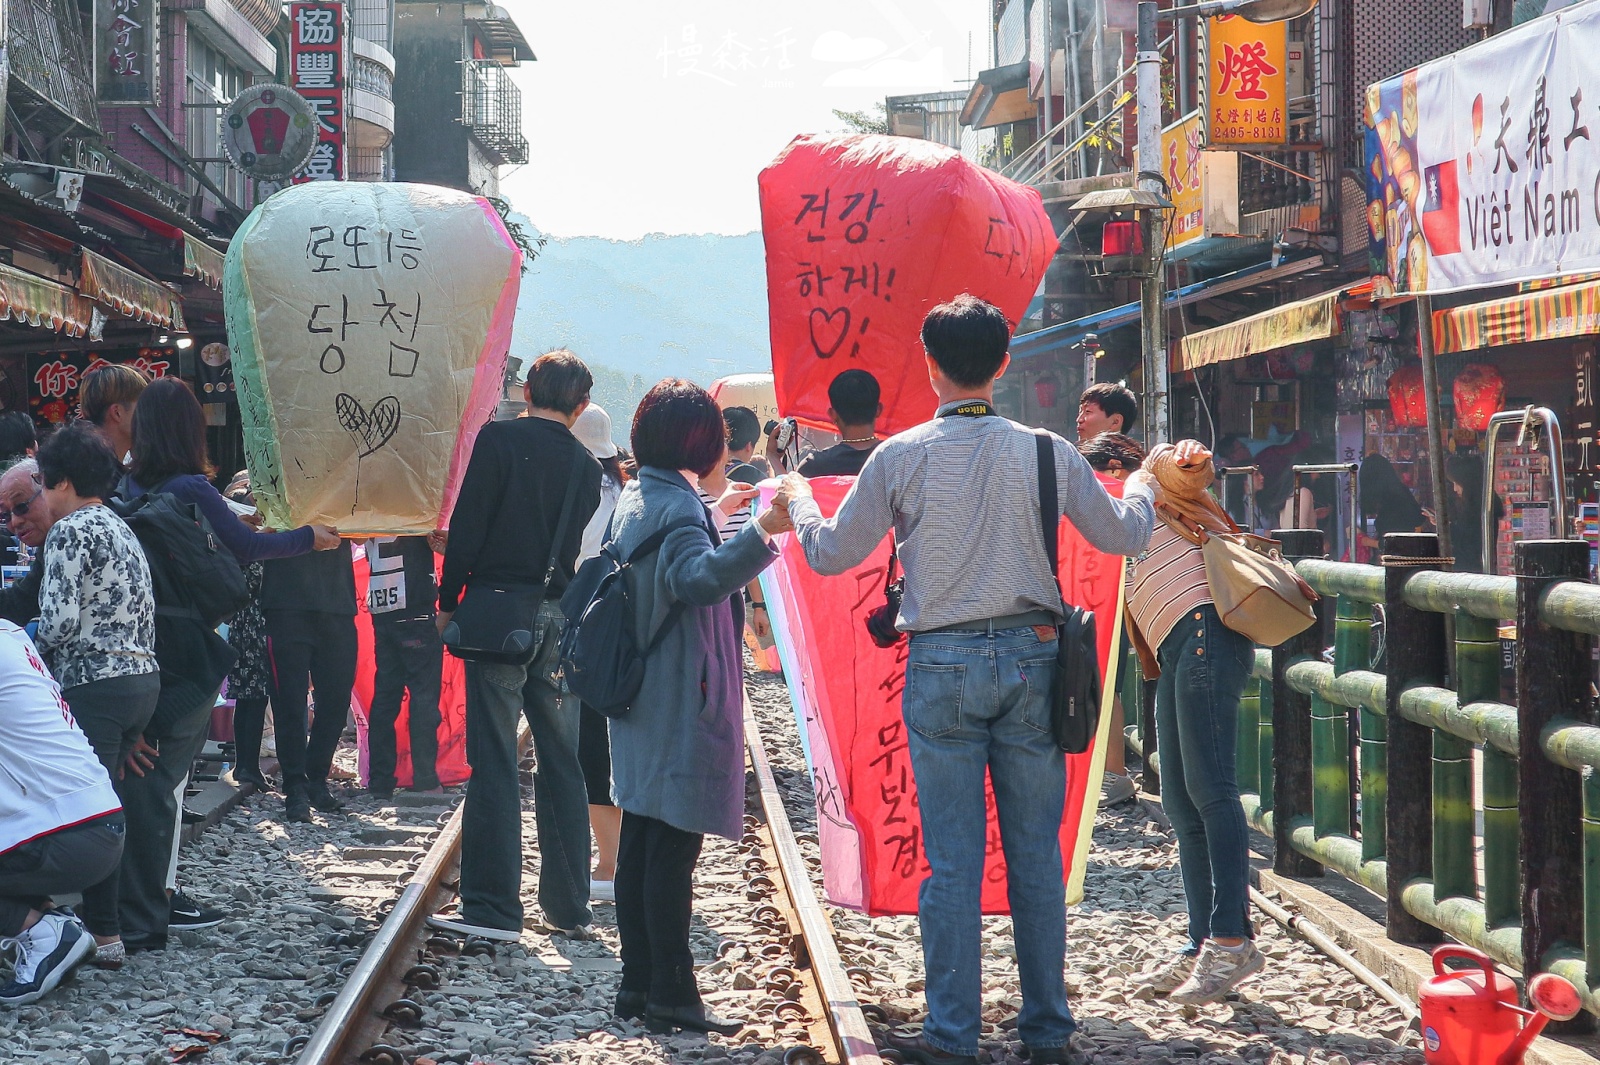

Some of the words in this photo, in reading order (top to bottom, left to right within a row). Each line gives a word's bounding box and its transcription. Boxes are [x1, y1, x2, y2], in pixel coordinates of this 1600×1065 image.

[295, 8, 336, 181] 協豐天燈
[1217, 14, 1278, 101] 燈
[1214, 107, 1281, 124] 天燈創始店
[1214, 126, 1282, 139] 2495-8131
[1491, 73, 1600, 174] 天鼎上
[794, 187, 885, 244] 건강
[1466, 189, 1514, 260] Việt
[1524, 181, 1580, 242] Nam
[307, 289, 421, 378] 당첨
[957, 405, 987, 415] Nikon
